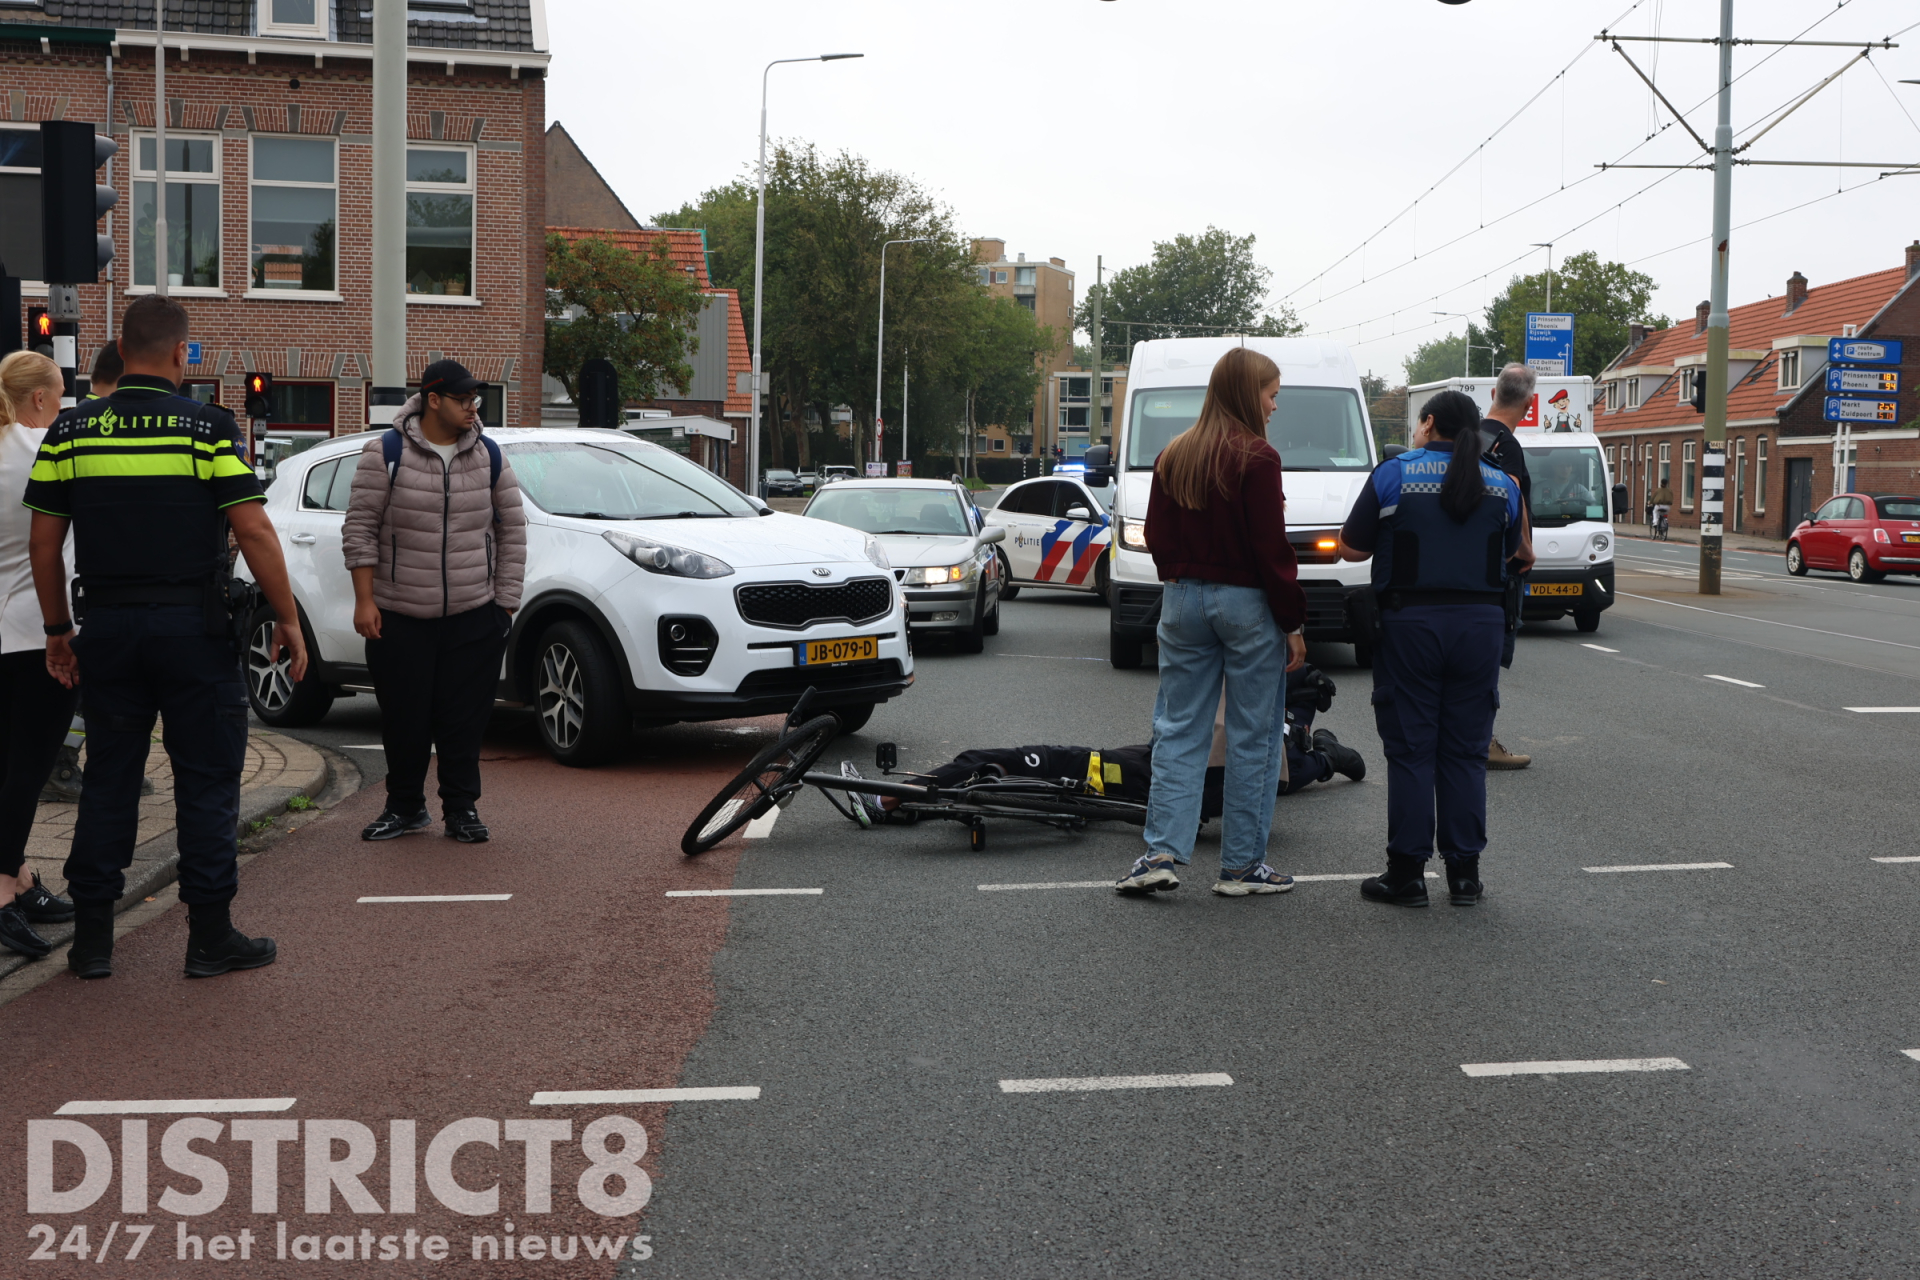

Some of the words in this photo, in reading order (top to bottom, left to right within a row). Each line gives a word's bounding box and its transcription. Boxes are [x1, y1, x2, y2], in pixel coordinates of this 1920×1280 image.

[1883, 373, 1897, 381] 187
[1459, 384, 1475, 392] 799
[1885, 382, 1896, 390] 94
[1841, 410, 1873, 418] Zuidpoort
[87, 413, 178, 436] POLITIE
[1014, 535, 1040, 548] POLITIE
[812, 567, 831, 577] KIA
[1532, 585, 1580, 594] VDL-44-D
[811, 640, 872, 661] JB-079-D
